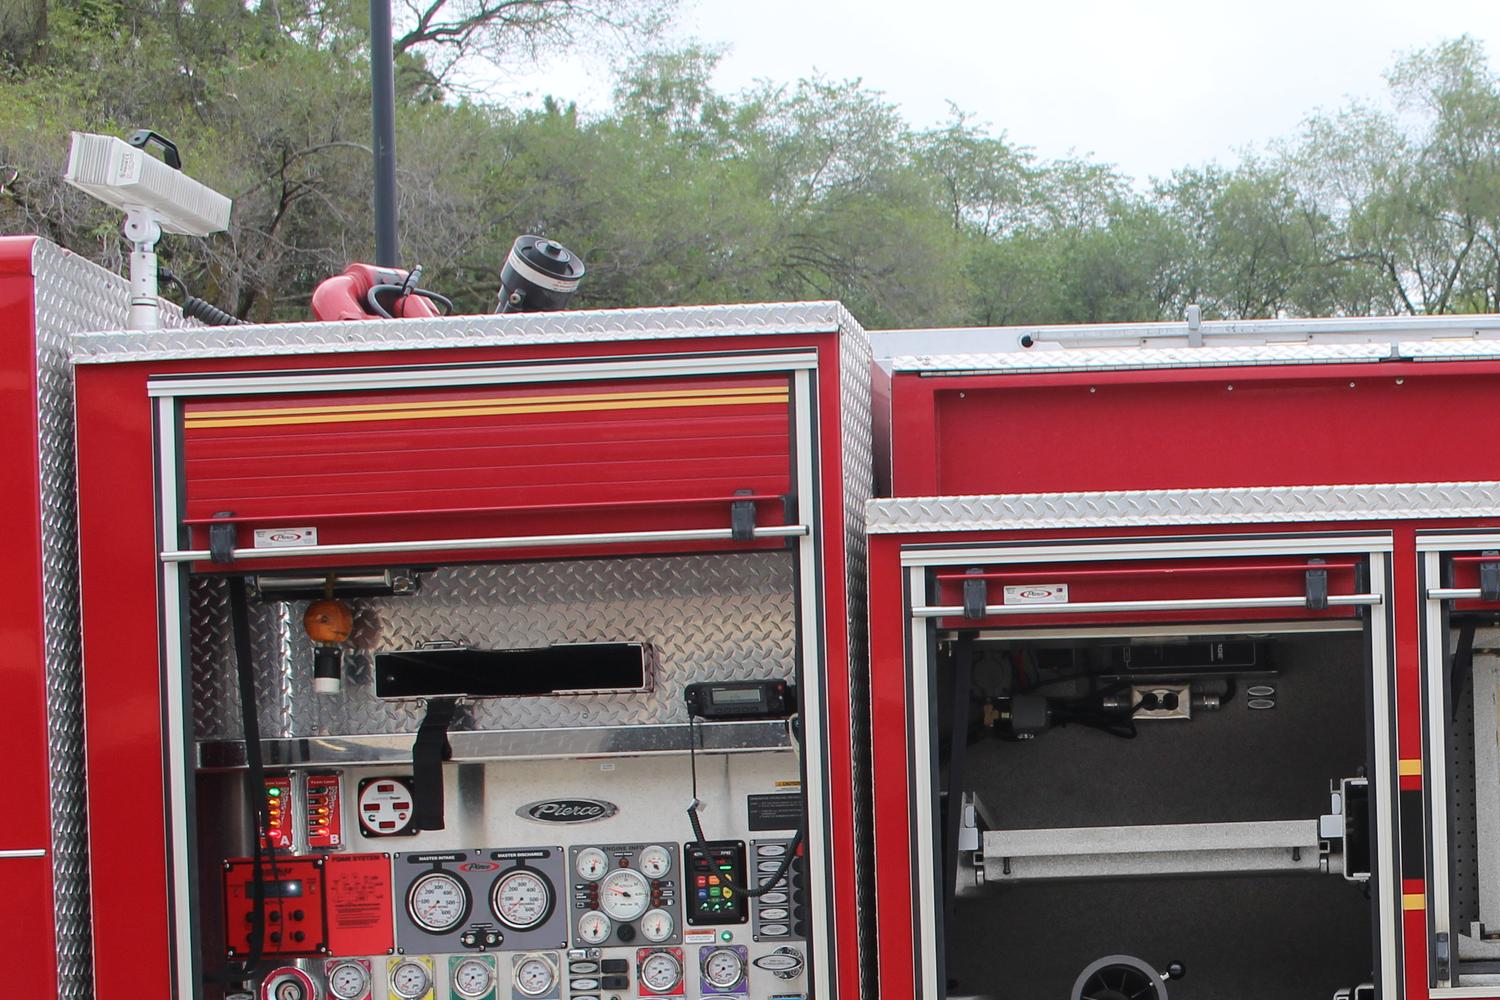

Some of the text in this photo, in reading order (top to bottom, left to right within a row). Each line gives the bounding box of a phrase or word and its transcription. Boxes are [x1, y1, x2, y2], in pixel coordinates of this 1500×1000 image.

[533, 803, 602, 818] Pierce
[280, 835, 290, 846] A
[330, 834, 340, 845] B
